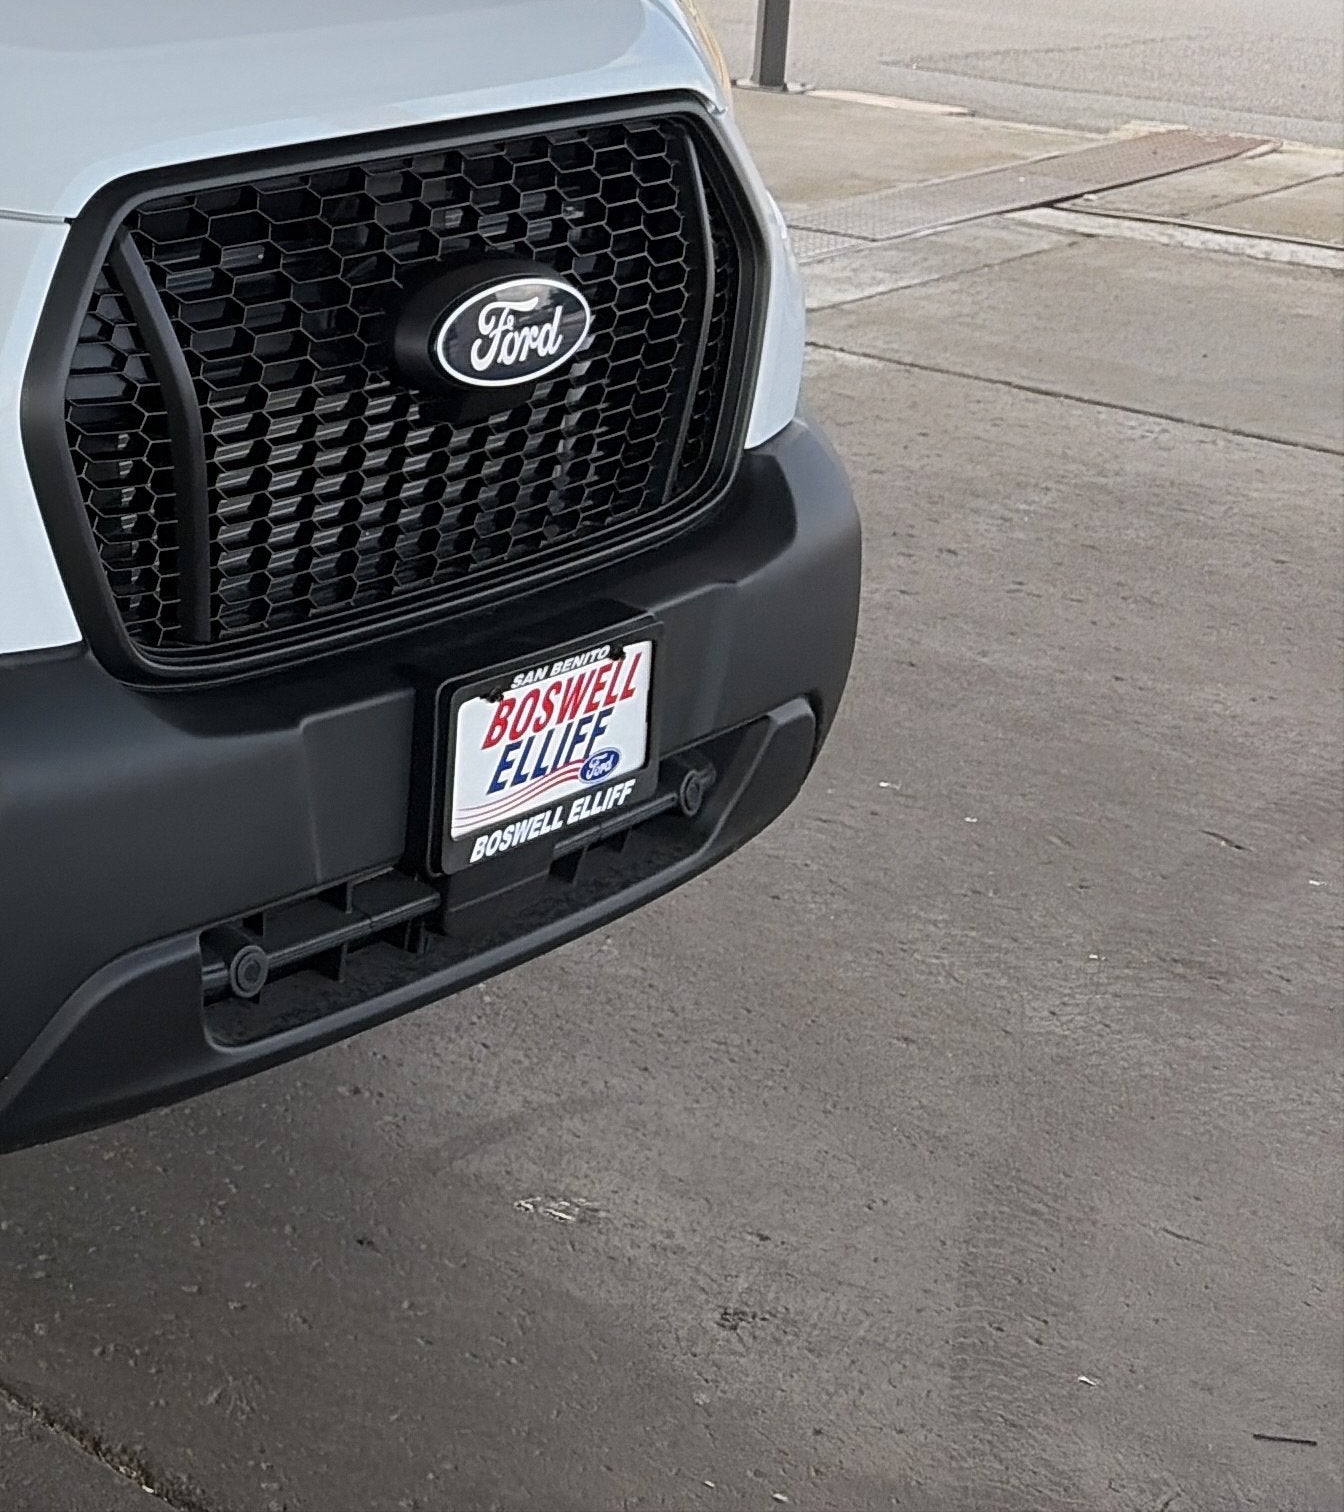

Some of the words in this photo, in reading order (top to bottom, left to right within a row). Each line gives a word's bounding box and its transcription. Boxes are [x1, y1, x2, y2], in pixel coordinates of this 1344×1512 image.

[470, 296, 563, 372] Ford
[481, 652, 643, 750] BOSWELL
[510, 666, 550, 689] SAN
[550, 645, 611, 676] BENITO
[486, 706, 615, 795] ELLIFF
[586, 755, 615, 781] Ford
[469, 805, 564, 864] BOSWELL
[566, 778, 637, 826] ELLIFF
